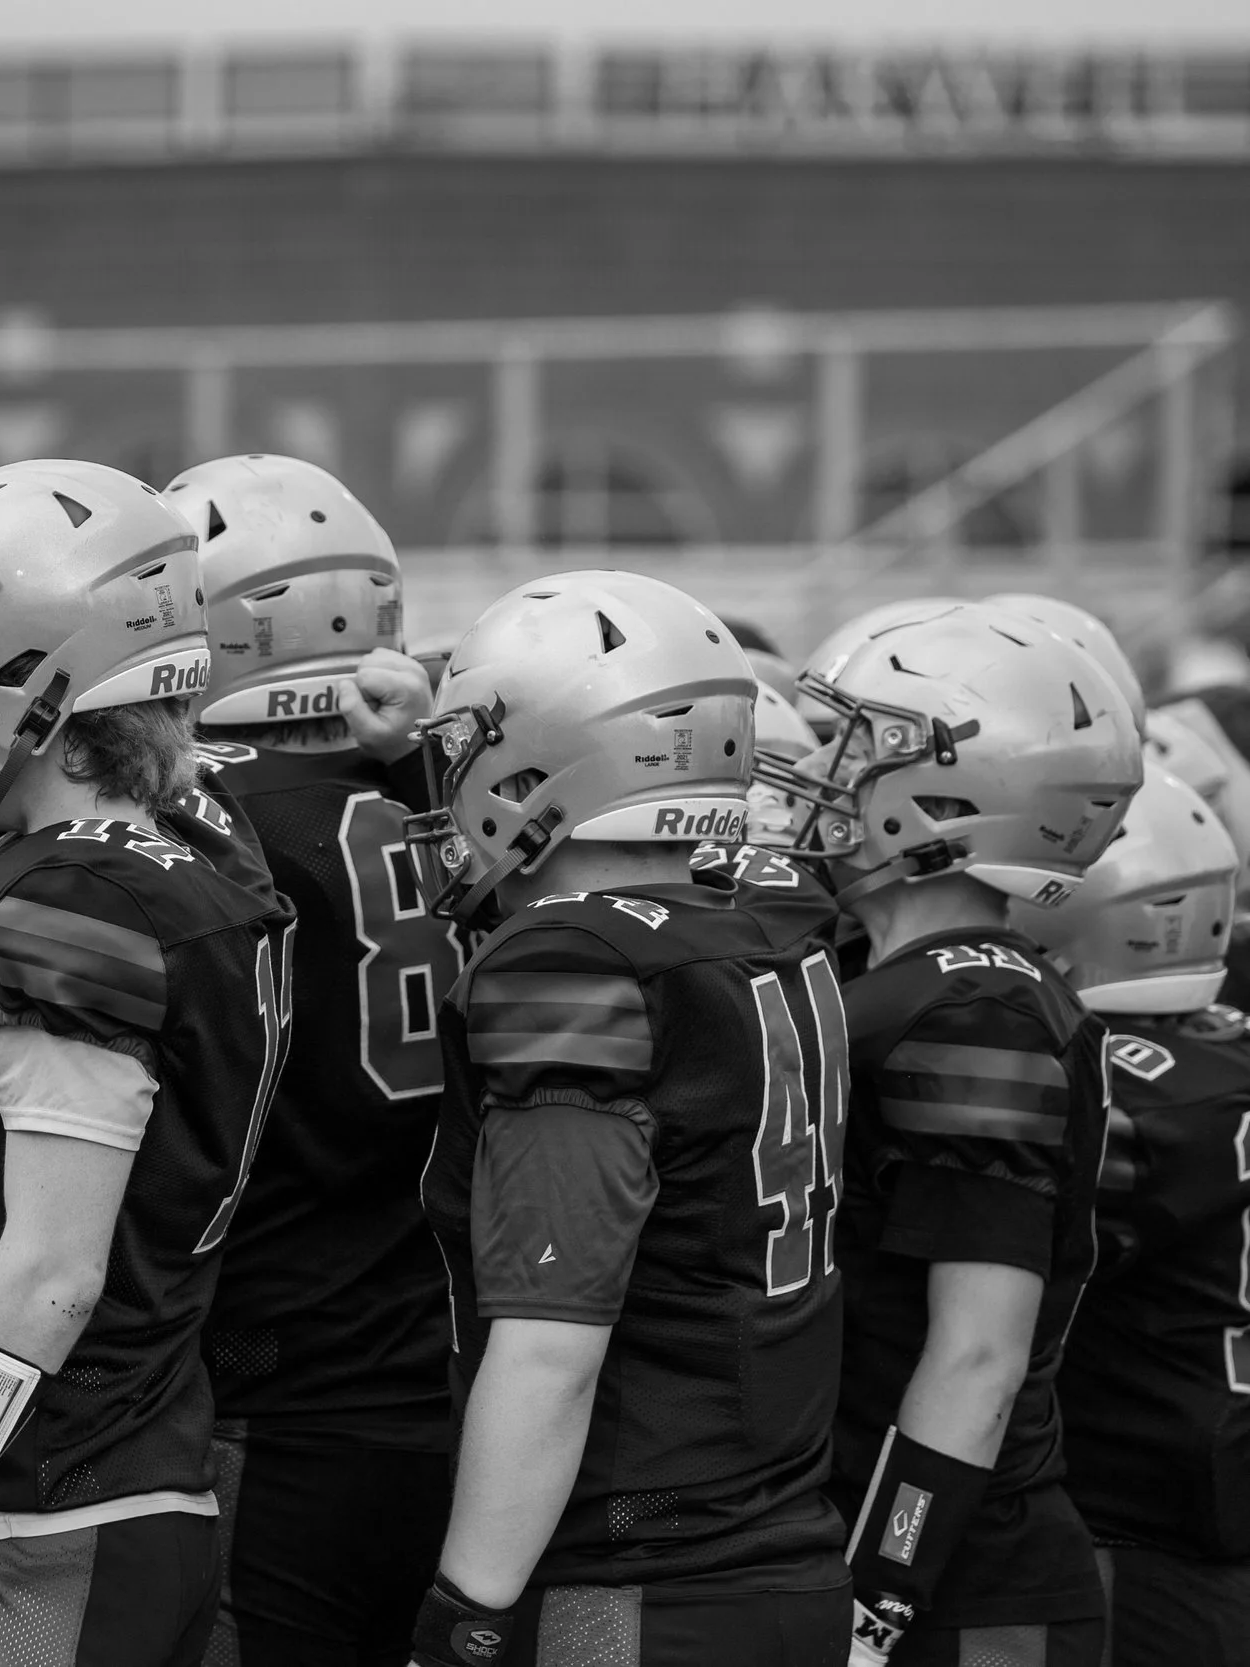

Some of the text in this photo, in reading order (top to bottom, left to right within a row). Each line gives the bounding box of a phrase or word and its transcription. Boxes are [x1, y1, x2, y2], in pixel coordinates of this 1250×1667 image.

[125, 616, 156, 629] Riddell
[149, 658, 210, 697] Ridd
[266, 685, 340, 718] Rid
[634, 755, 670, 764] Riddell
[901, 1493, 926, 1560] CUTTERS
